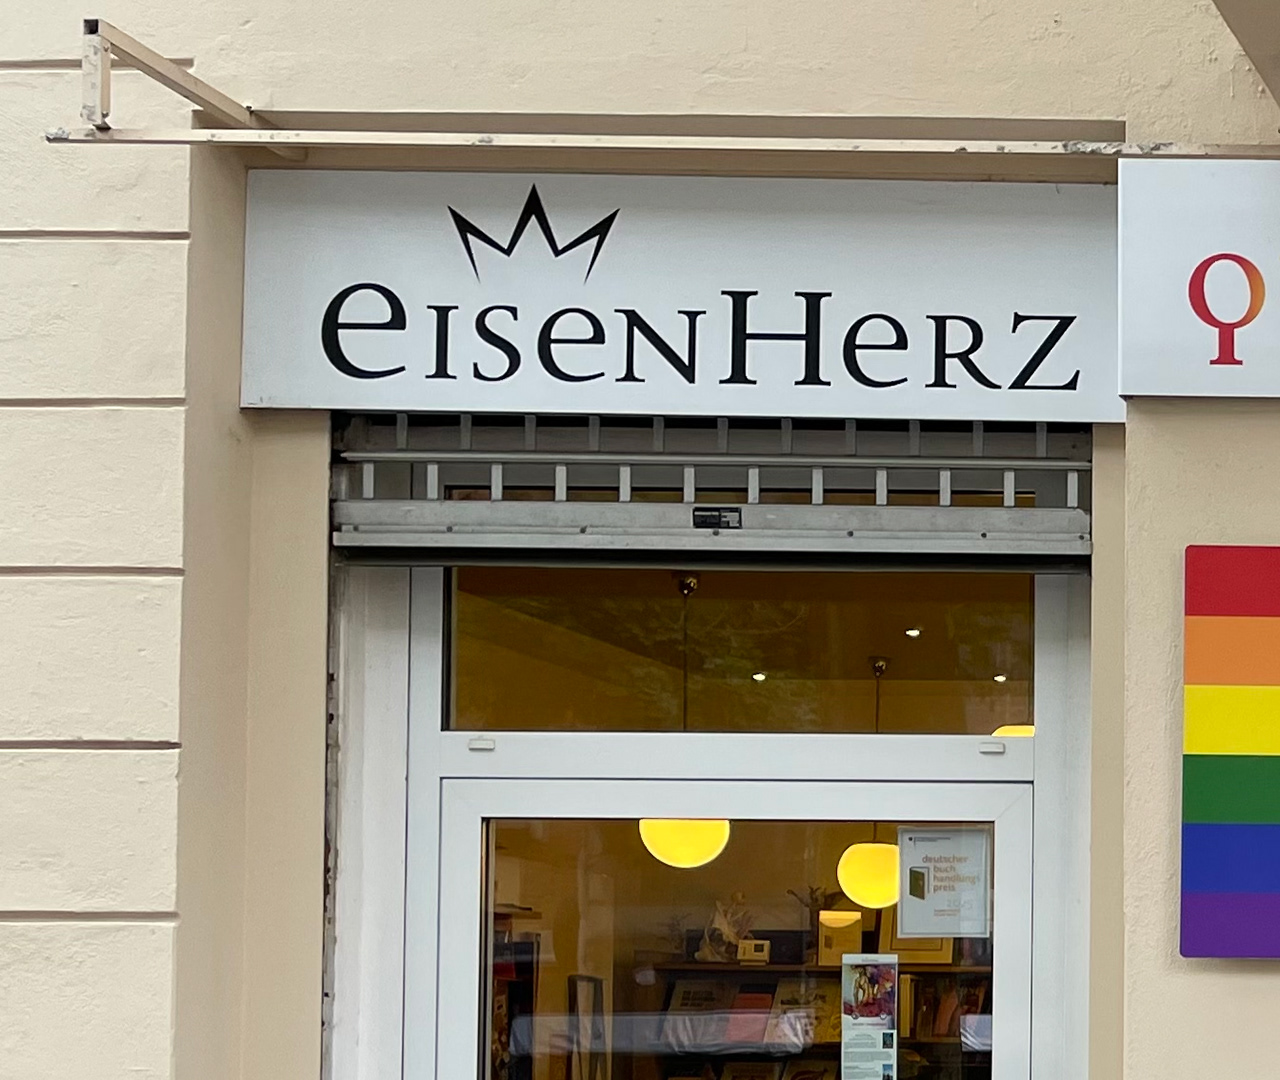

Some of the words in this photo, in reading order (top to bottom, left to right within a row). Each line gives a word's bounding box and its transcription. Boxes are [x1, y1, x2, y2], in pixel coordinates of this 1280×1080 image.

[922, 854, 968, 863] deutscher
[933, 865, 955, 873] buch
[933, 884, 955, 893] preis
